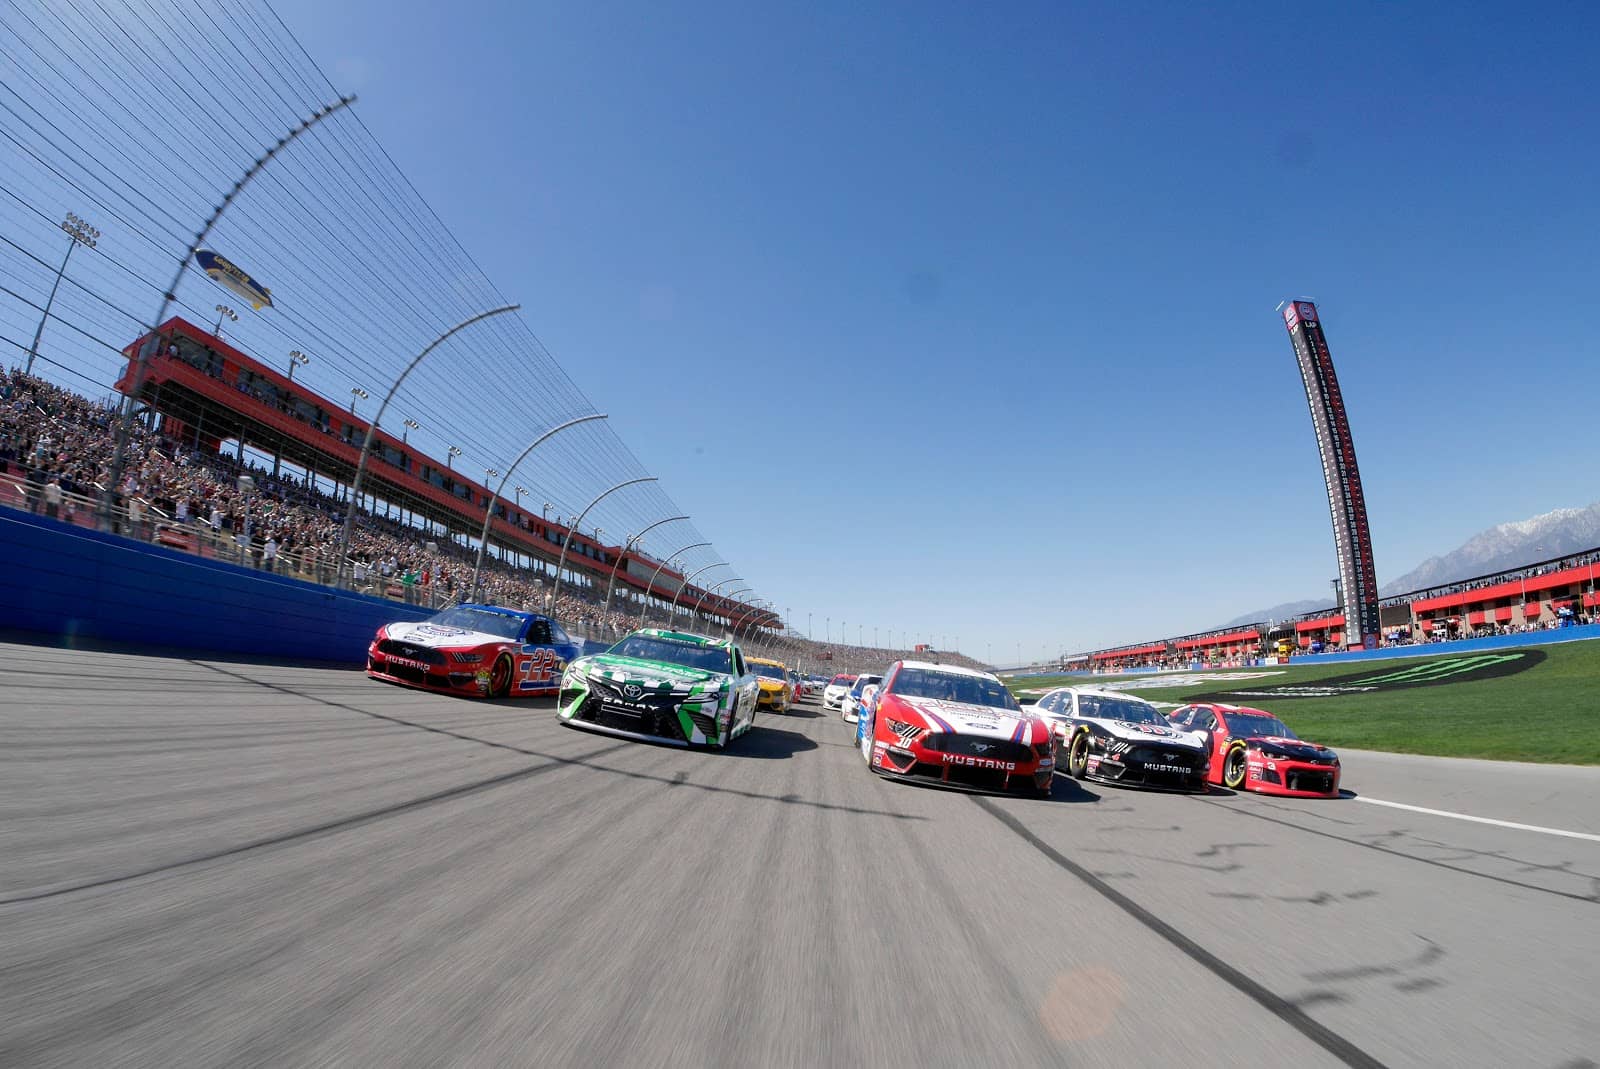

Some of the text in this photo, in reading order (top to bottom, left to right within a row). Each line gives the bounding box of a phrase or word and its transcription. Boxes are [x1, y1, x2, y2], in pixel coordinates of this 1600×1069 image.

[385, 655, 430, 671] MUSTANG
[527, 648, 557, 682] 22
[603, 697, 660, 710] CAMRY
[897, 737, 913, 749] 10
[942, 753, 1015, 770] MUSTANG
[1144, 762, 1191, 774] MUSTANG
